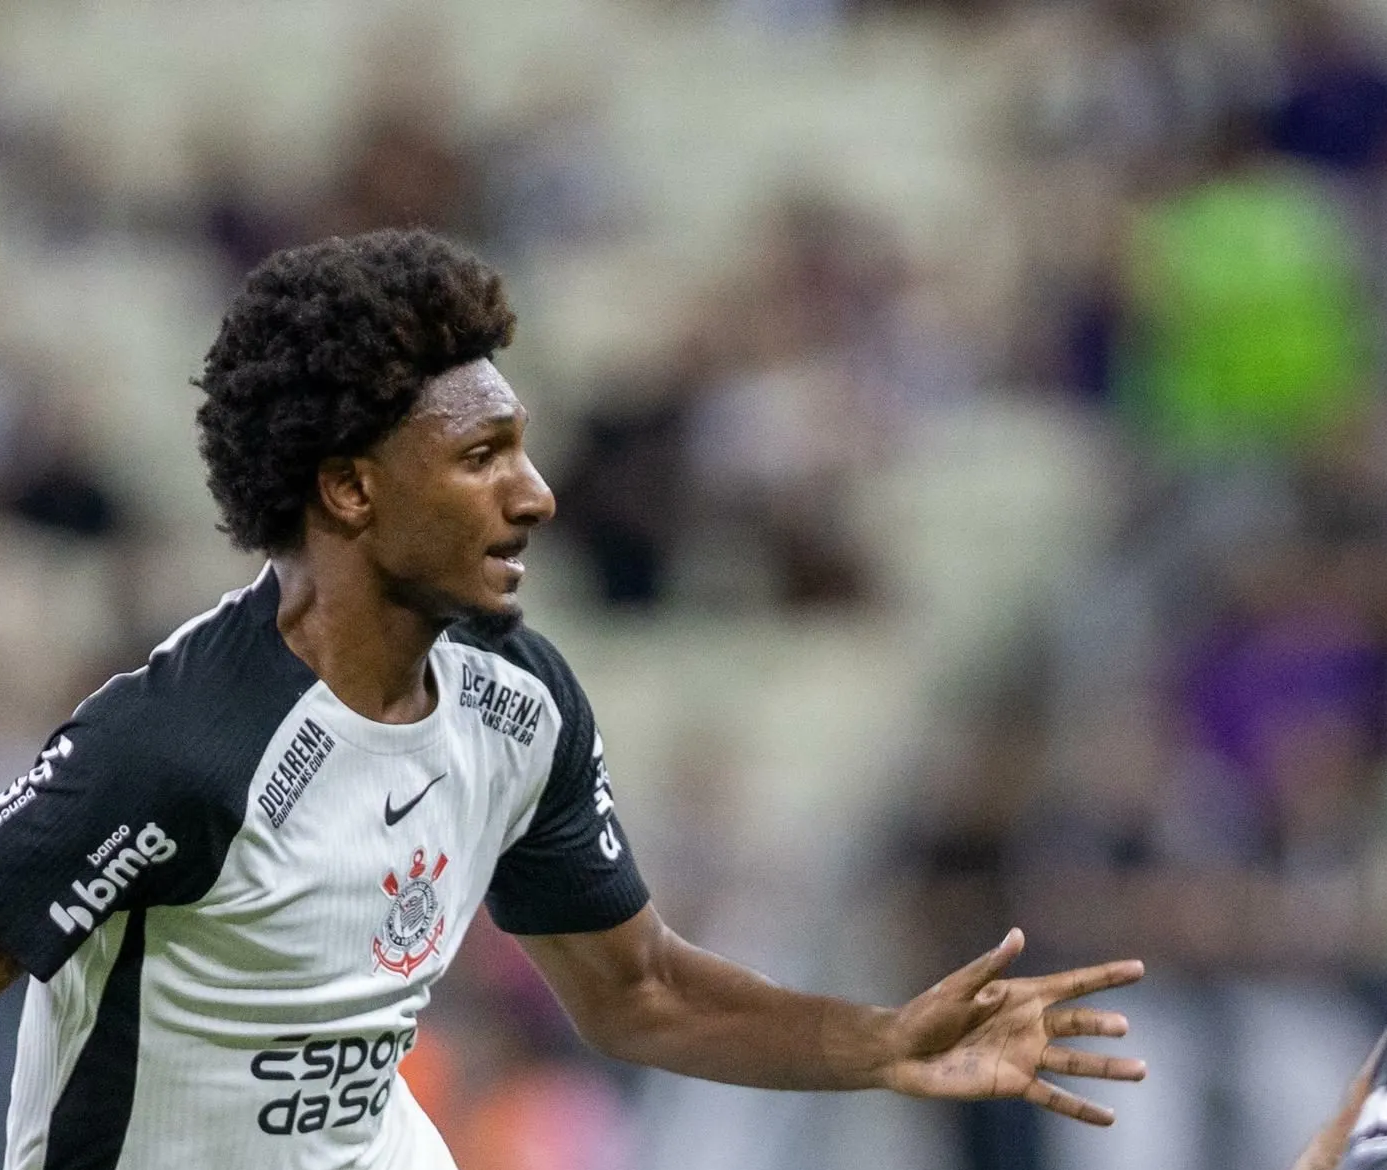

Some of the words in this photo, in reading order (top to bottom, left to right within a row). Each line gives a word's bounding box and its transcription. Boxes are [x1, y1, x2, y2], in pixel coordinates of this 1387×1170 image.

[462, 662, 542, 732] DEARENA
[257, 716, 326, 819] DOEARENA
[71, 822, 177, 913] bmg
[87, 824, 130, 866] banco
